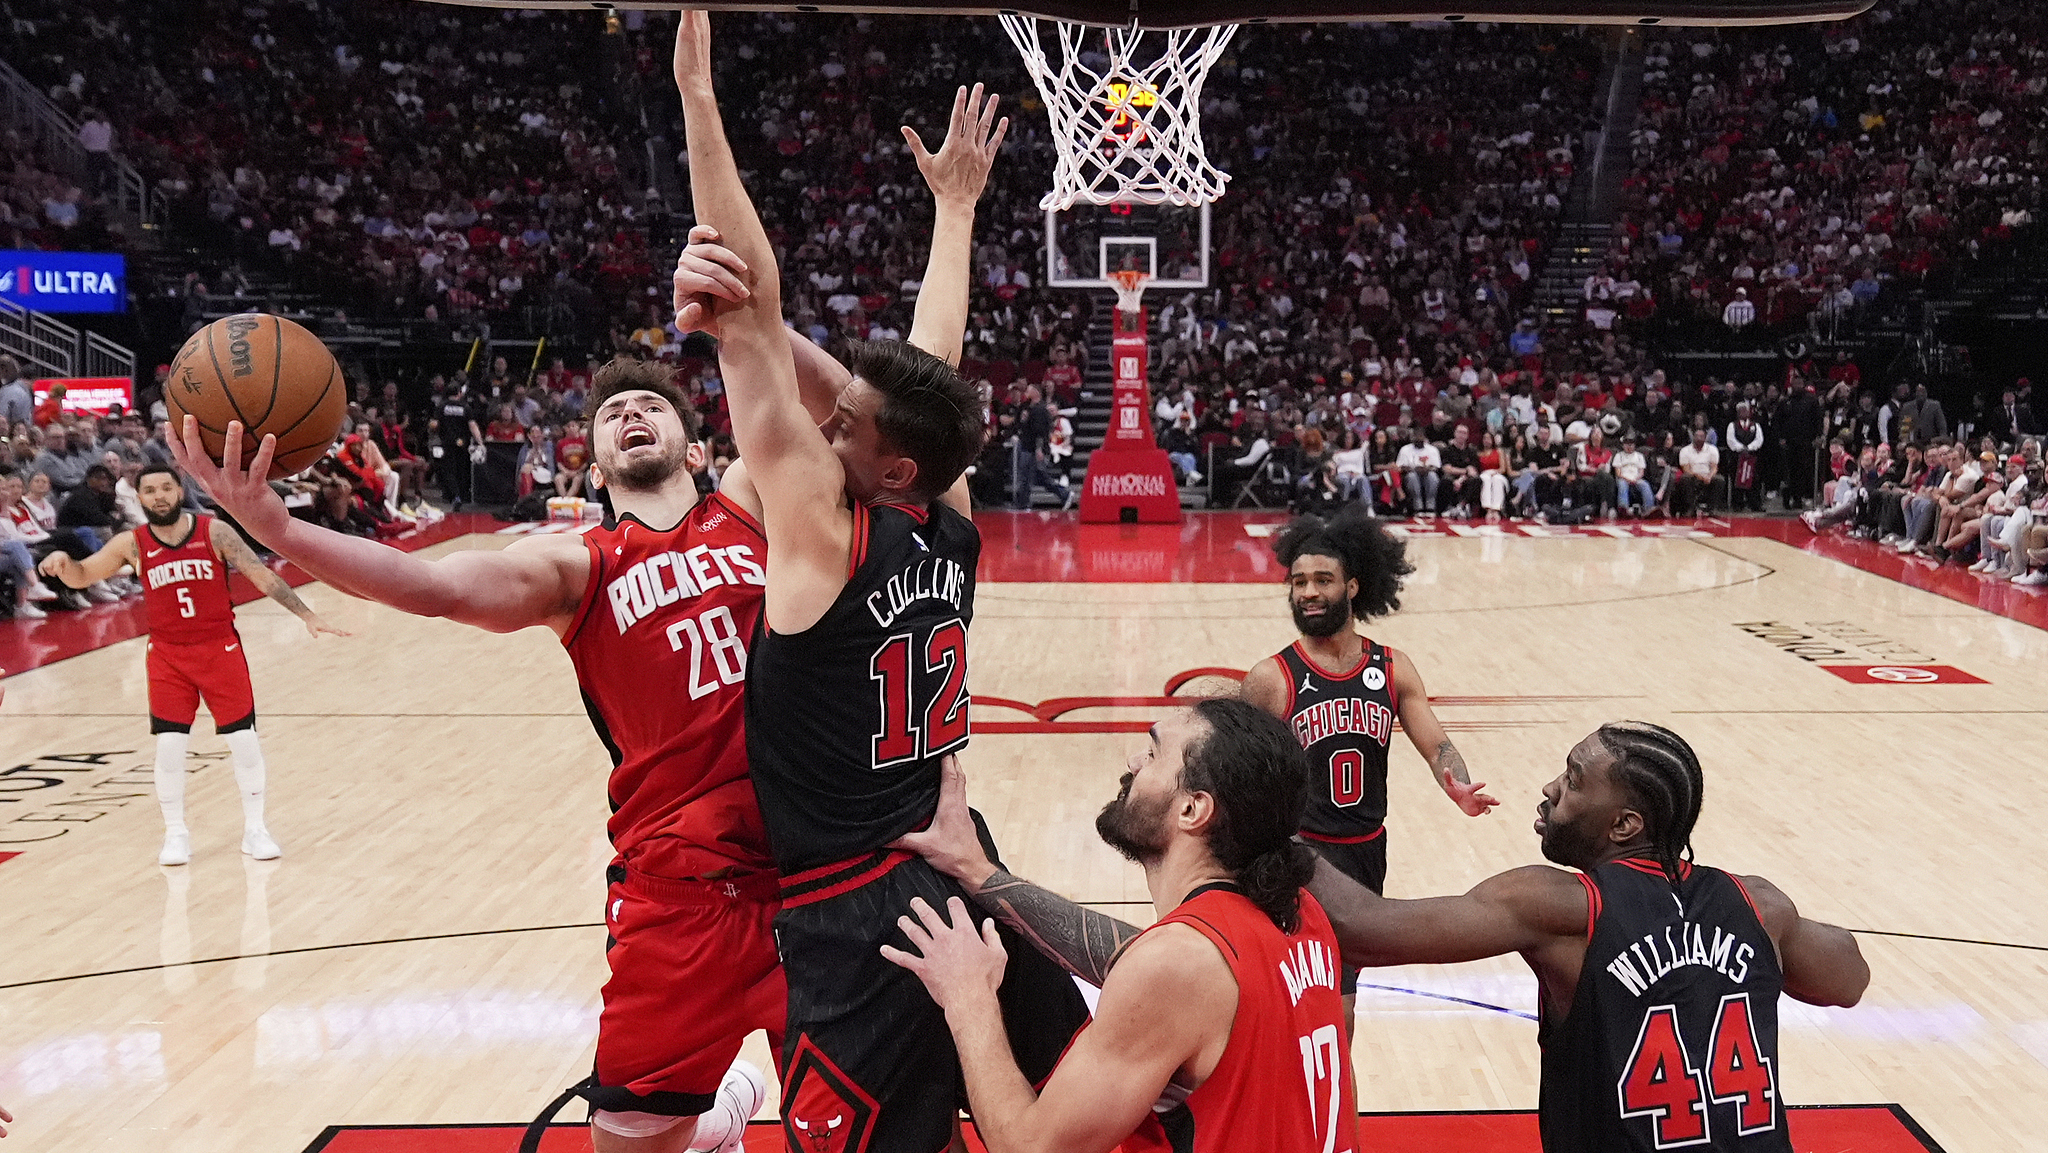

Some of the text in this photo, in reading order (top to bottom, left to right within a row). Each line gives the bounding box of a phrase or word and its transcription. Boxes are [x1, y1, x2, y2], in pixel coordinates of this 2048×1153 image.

[34, 269, 118, 295] ULTRA
[147, 559, 214, 590] ROCKETS
[176, 587, 196, 619] 5
[606, 543, 767, 636] ROCKETS
[866, 557, 965, 628] COLLINS
[666, 605, 748, 700] 28
[870, 617, 970, 769] 12
[1291, 697, 1391, 750] CHICAGO
[1329, 748, 1364, 808] 0
[1606, 921, 1755, 997] WILLIAMS
[1617, 992, 1776, 1150] 44
